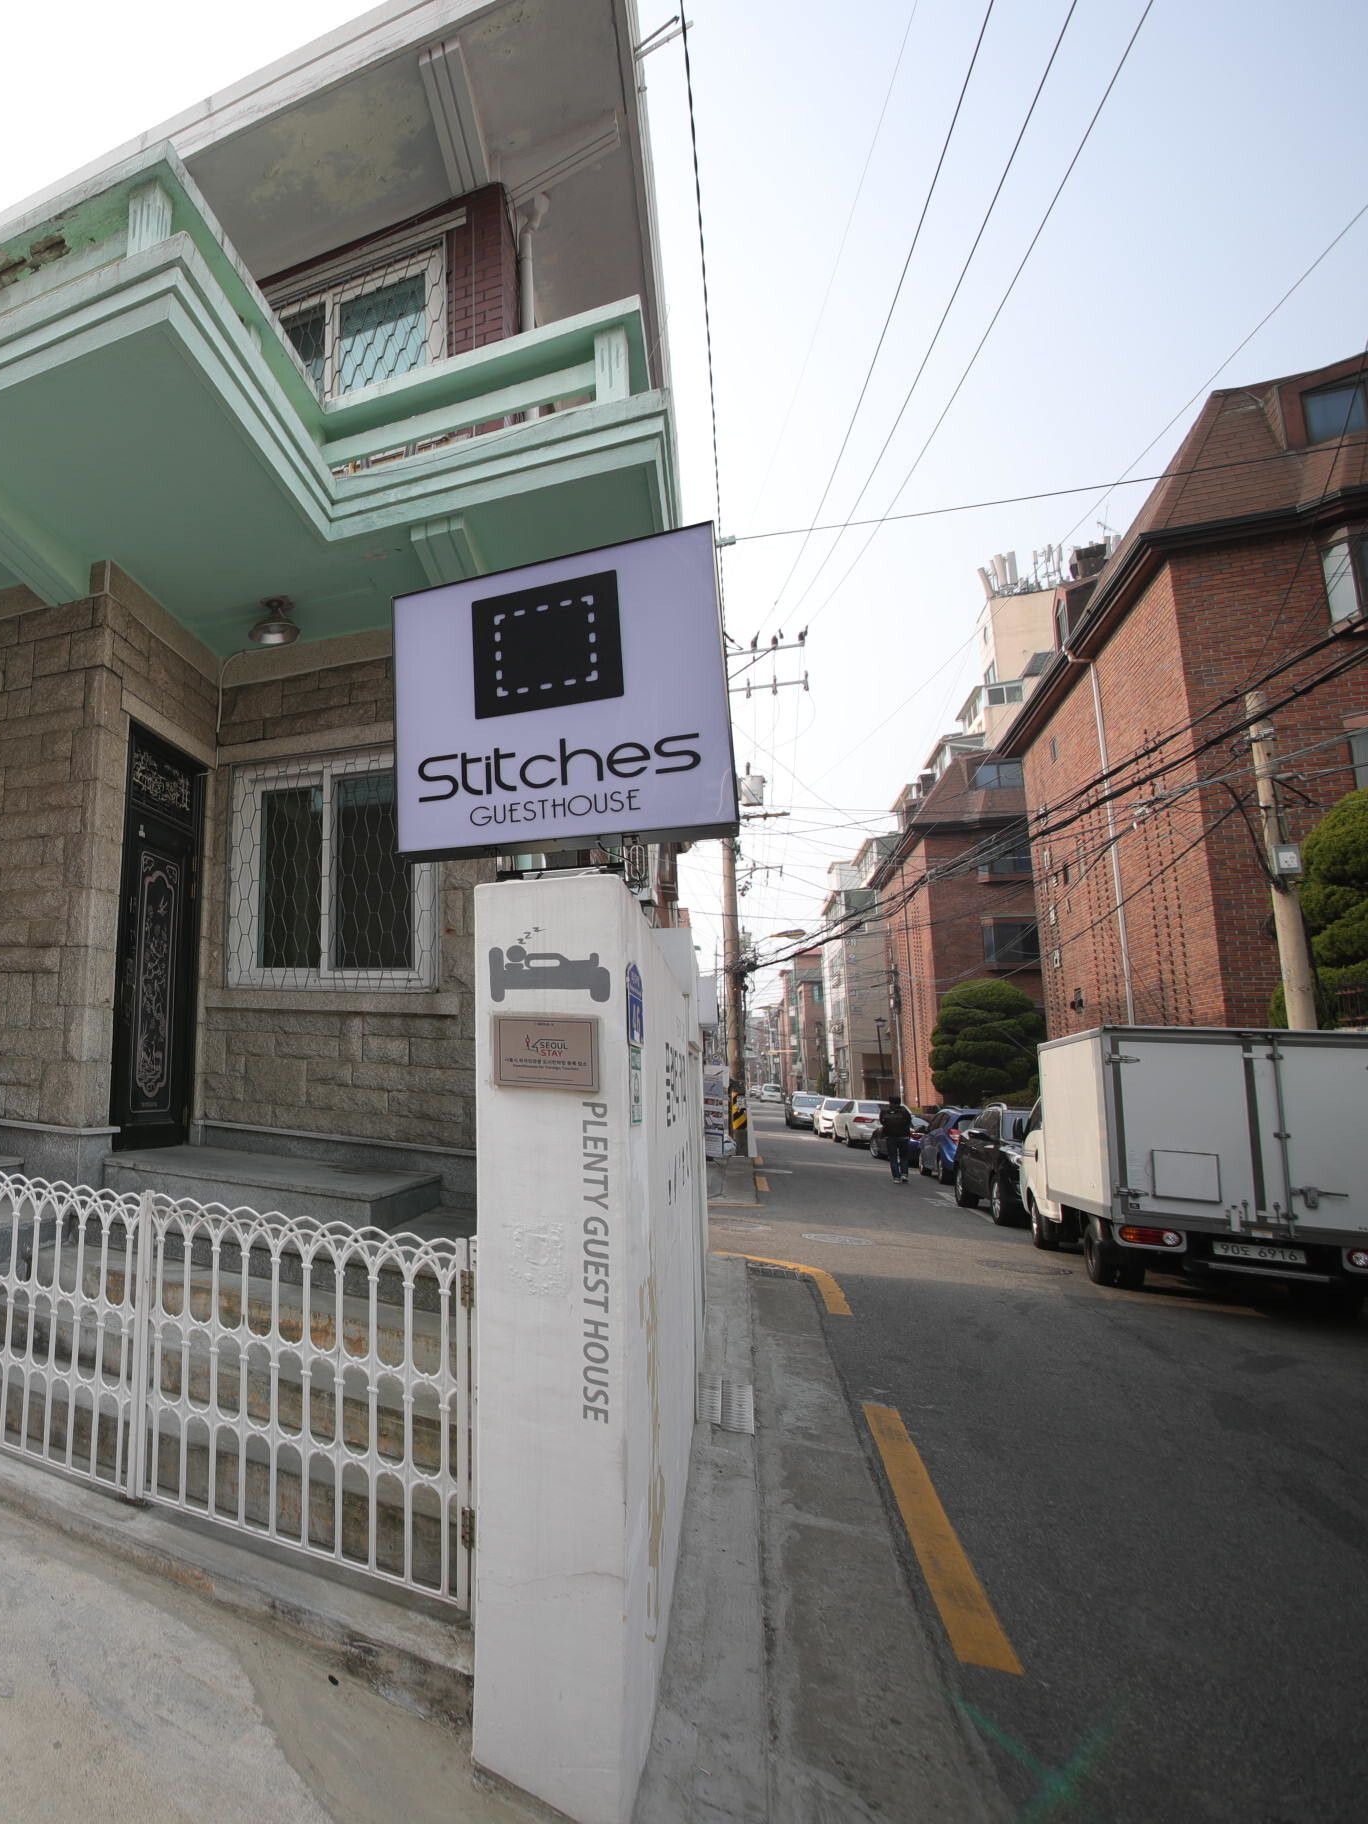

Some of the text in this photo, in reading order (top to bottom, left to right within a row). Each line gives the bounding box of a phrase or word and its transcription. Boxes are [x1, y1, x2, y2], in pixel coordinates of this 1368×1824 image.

[418, 732, 701, 803] Stitches
[469, 788, 641, 827] GUESTHOUSE
[540, 1041, 568, 1050] SEOUL
[540, 1049, 563, 1057] STAY
[582, 1101, 609, 1425] PLENTY GUEST HOUSE
[1258, 1247, 1298, 1261] 6916
